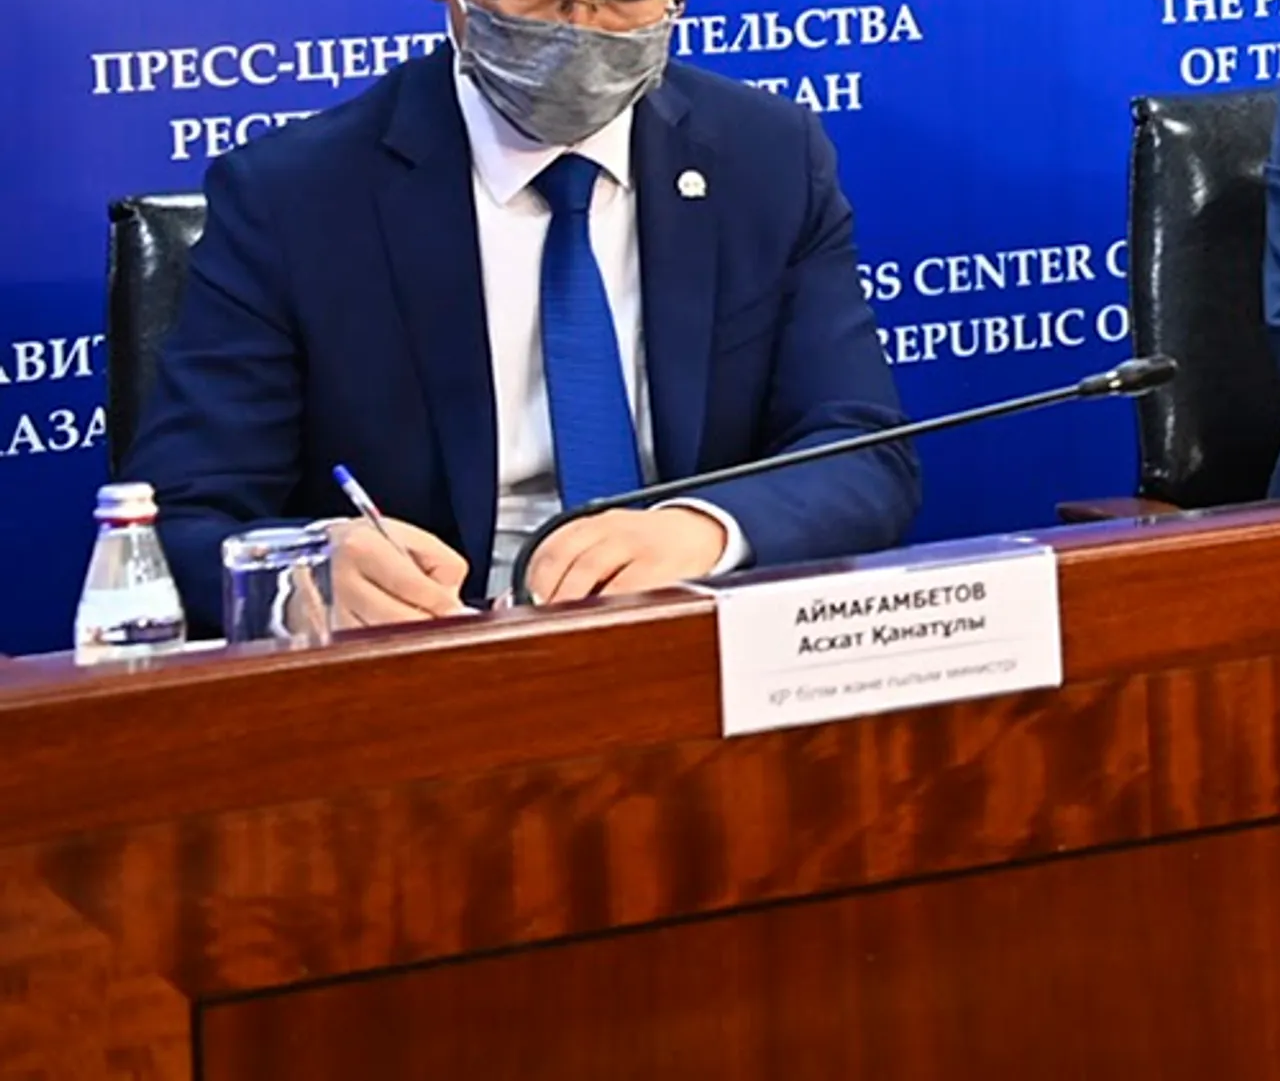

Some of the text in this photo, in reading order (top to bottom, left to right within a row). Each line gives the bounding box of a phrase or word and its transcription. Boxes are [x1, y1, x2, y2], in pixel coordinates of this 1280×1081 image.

[1180, 46, 1238, 86] OF
[914, 244, 1095, 295] CENTER
[876, 308, 1084, 364] REPUBLIC
[795, 581, 987, 626] АЙМАҒАМБЕТОВ
[798, 631, 865, 655] Асхат
